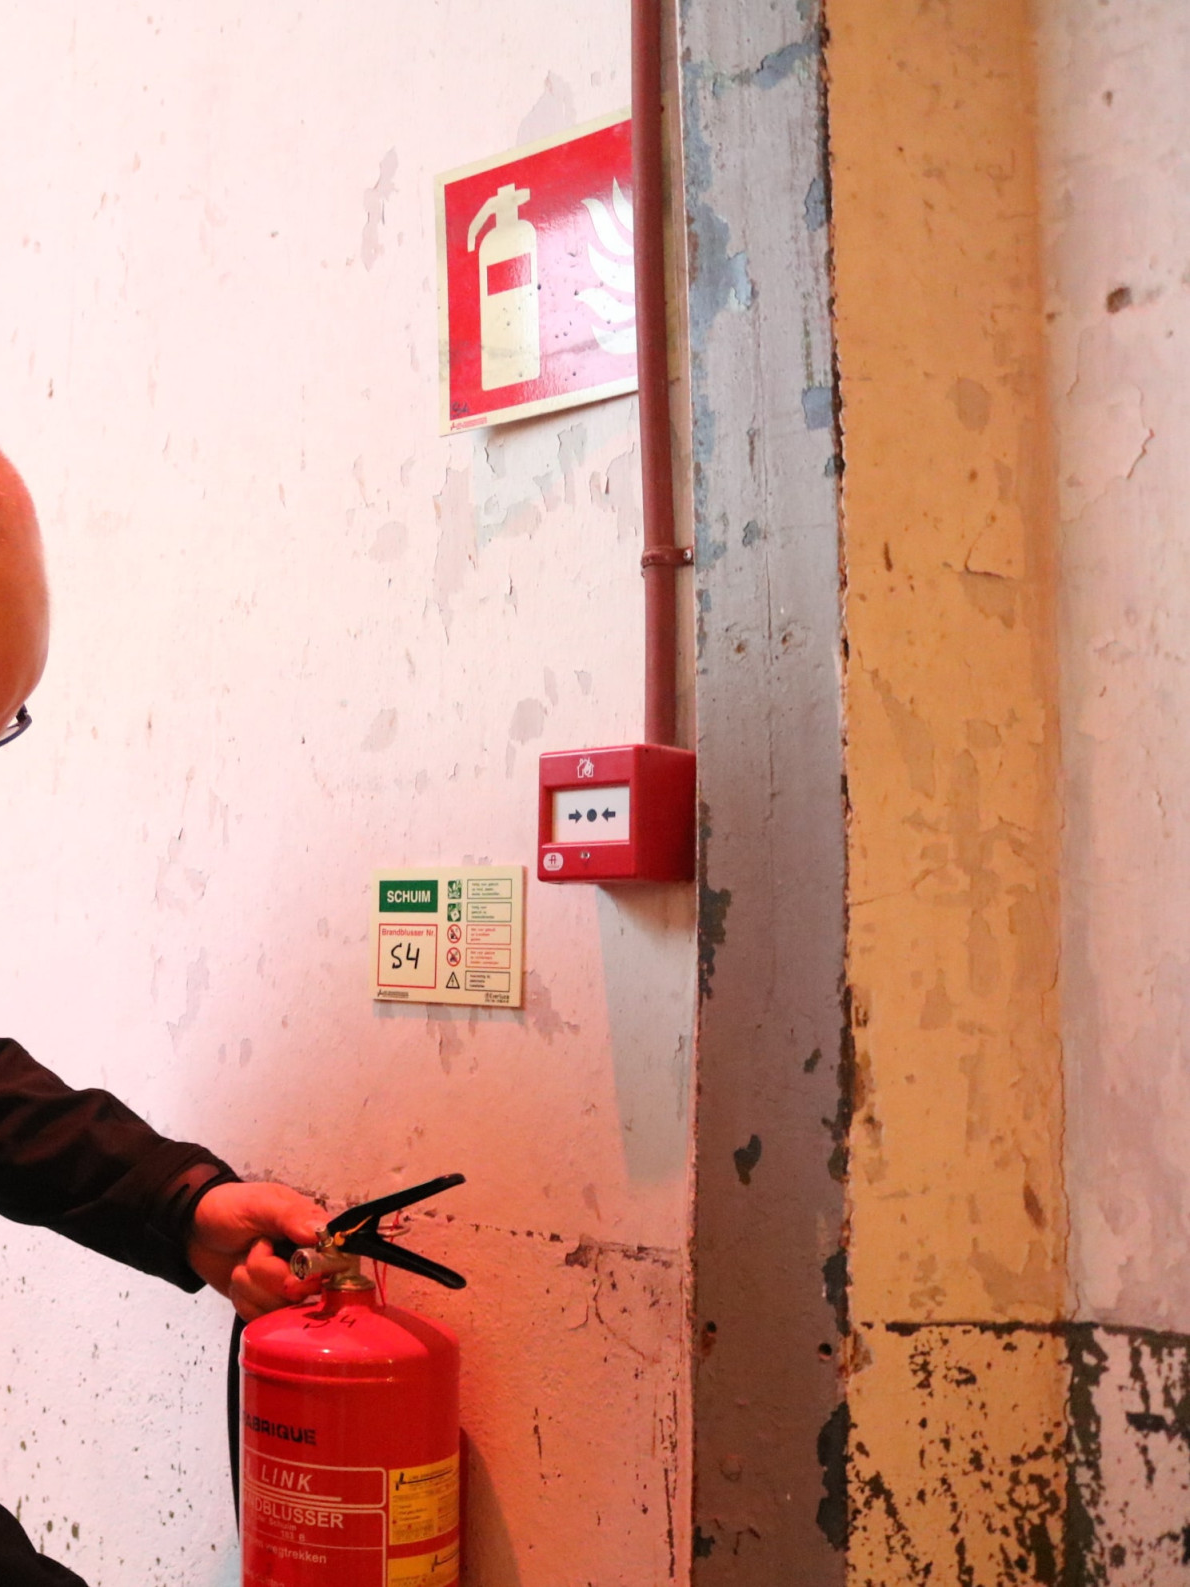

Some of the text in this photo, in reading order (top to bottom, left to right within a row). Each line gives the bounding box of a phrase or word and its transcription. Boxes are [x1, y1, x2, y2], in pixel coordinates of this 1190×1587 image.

[387, 890, 431, 903] SCHUIM
[381, 928, 424, 936] Brandblusser
[391, 942, 420, 969] S4
[261, 1464, 313, 1493] LINK
